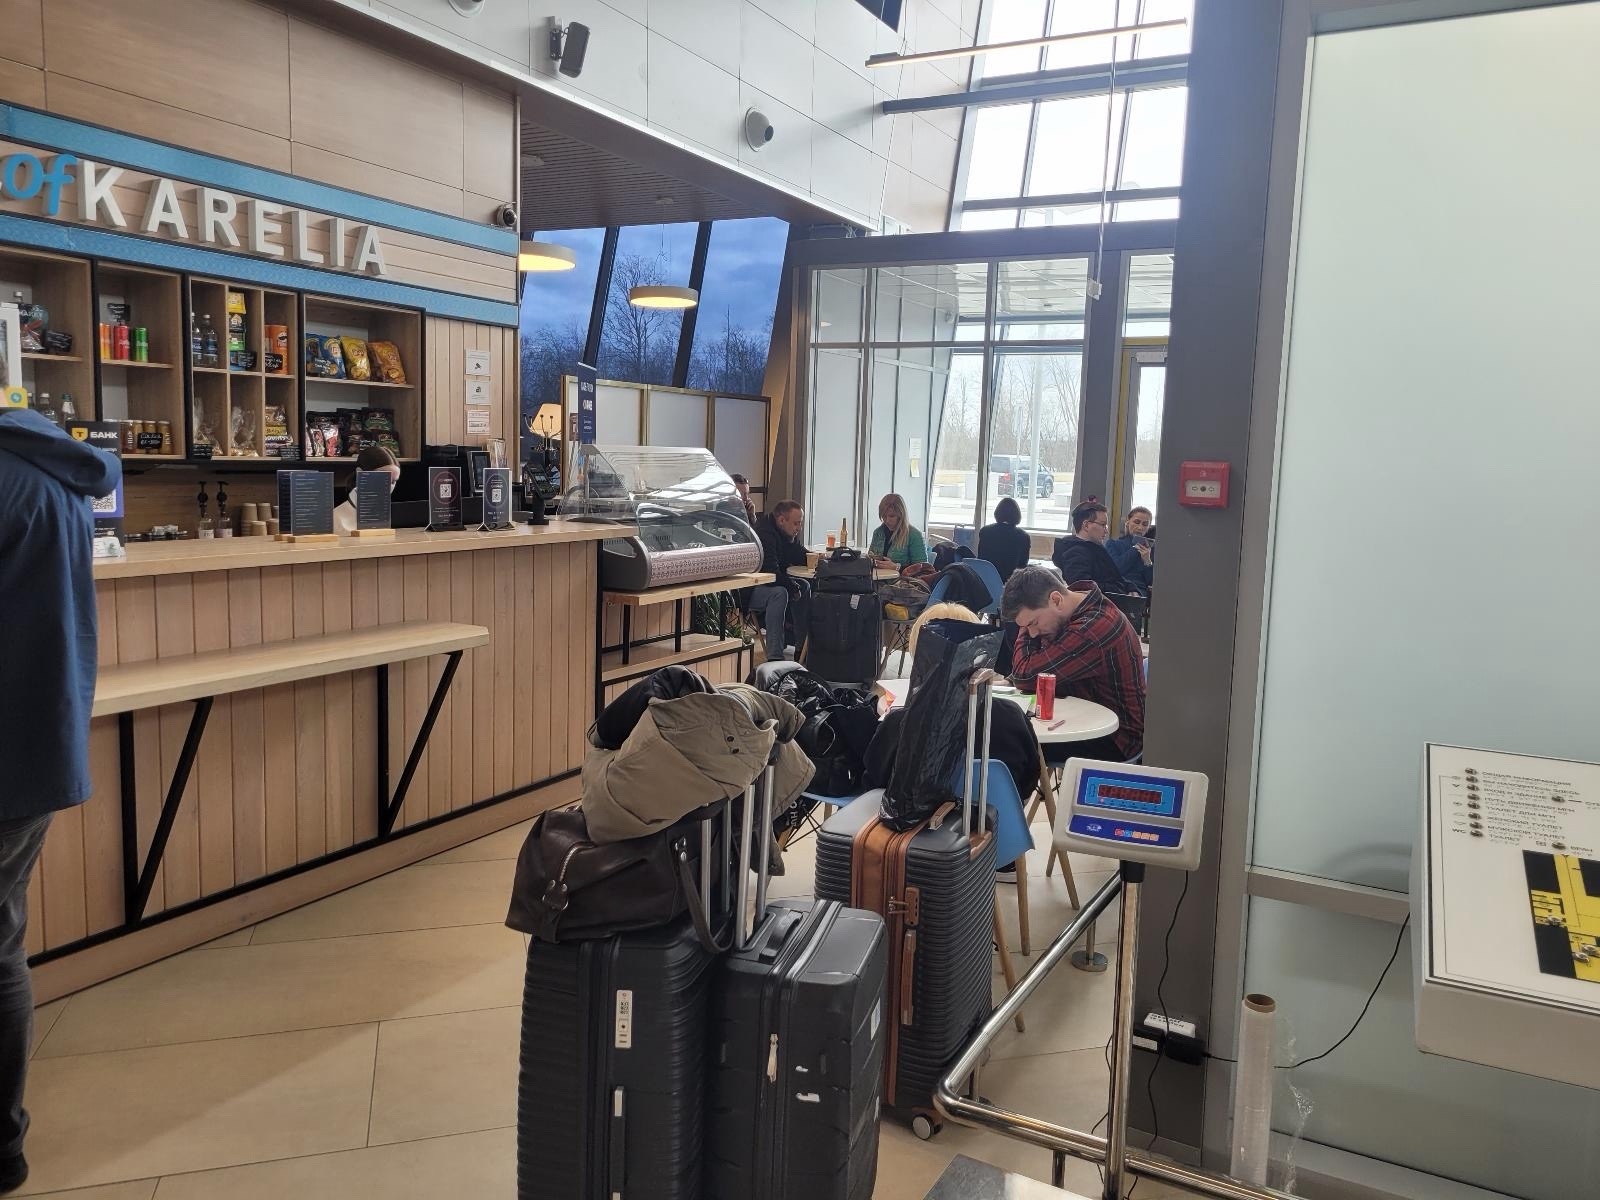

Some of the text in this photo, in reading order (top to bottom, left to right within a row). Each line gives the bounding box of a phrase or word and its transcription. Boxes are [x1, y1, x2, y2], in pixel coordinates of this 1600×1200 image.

[4, 152, 387, 274] of KARELIA
[90, 431, 118, 440] БАНК
[1486, 806, 1516, 814] ТУАЛЕТ
[1487, 815, 1563, 831] ЖЕНСКИЙ ТУАЛЕТ
[1452, 827, 1467, 835] WC
[1487, 825, 1566, 841] МУЖСКОЙ ТУАЛЕТ
[1488, 834, 1521, 843] ТУАЛЕТ
